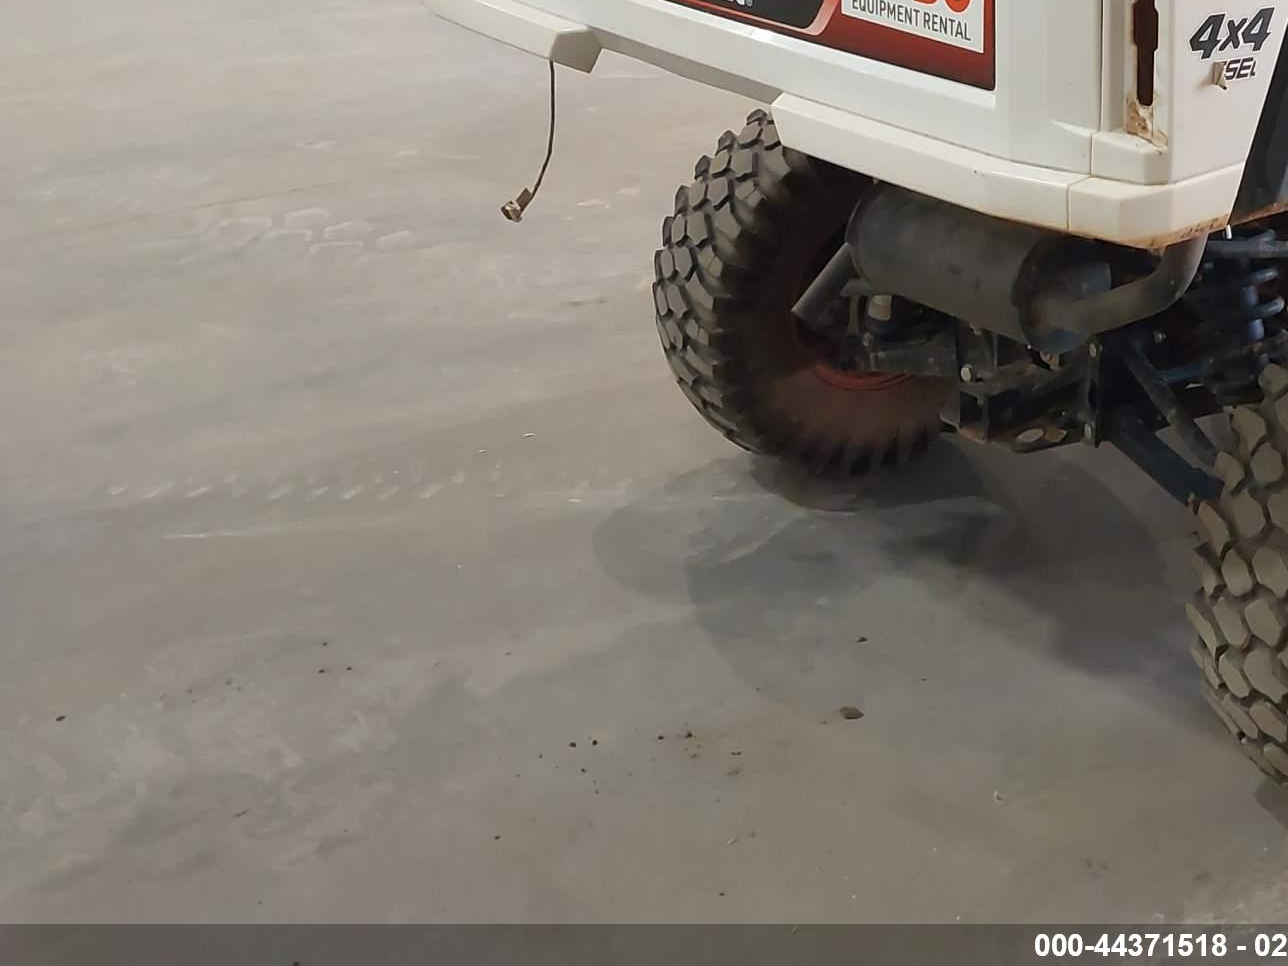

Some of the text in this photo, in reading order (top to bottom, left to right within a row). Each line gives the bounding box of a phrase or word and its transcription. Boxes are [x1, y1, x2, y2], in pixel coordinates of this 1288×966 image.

[922, 11, 972, 41] RENTAL
[1189, 7, 1275, 59] 4x4
[1221, 57, 1256, 81] SEL
